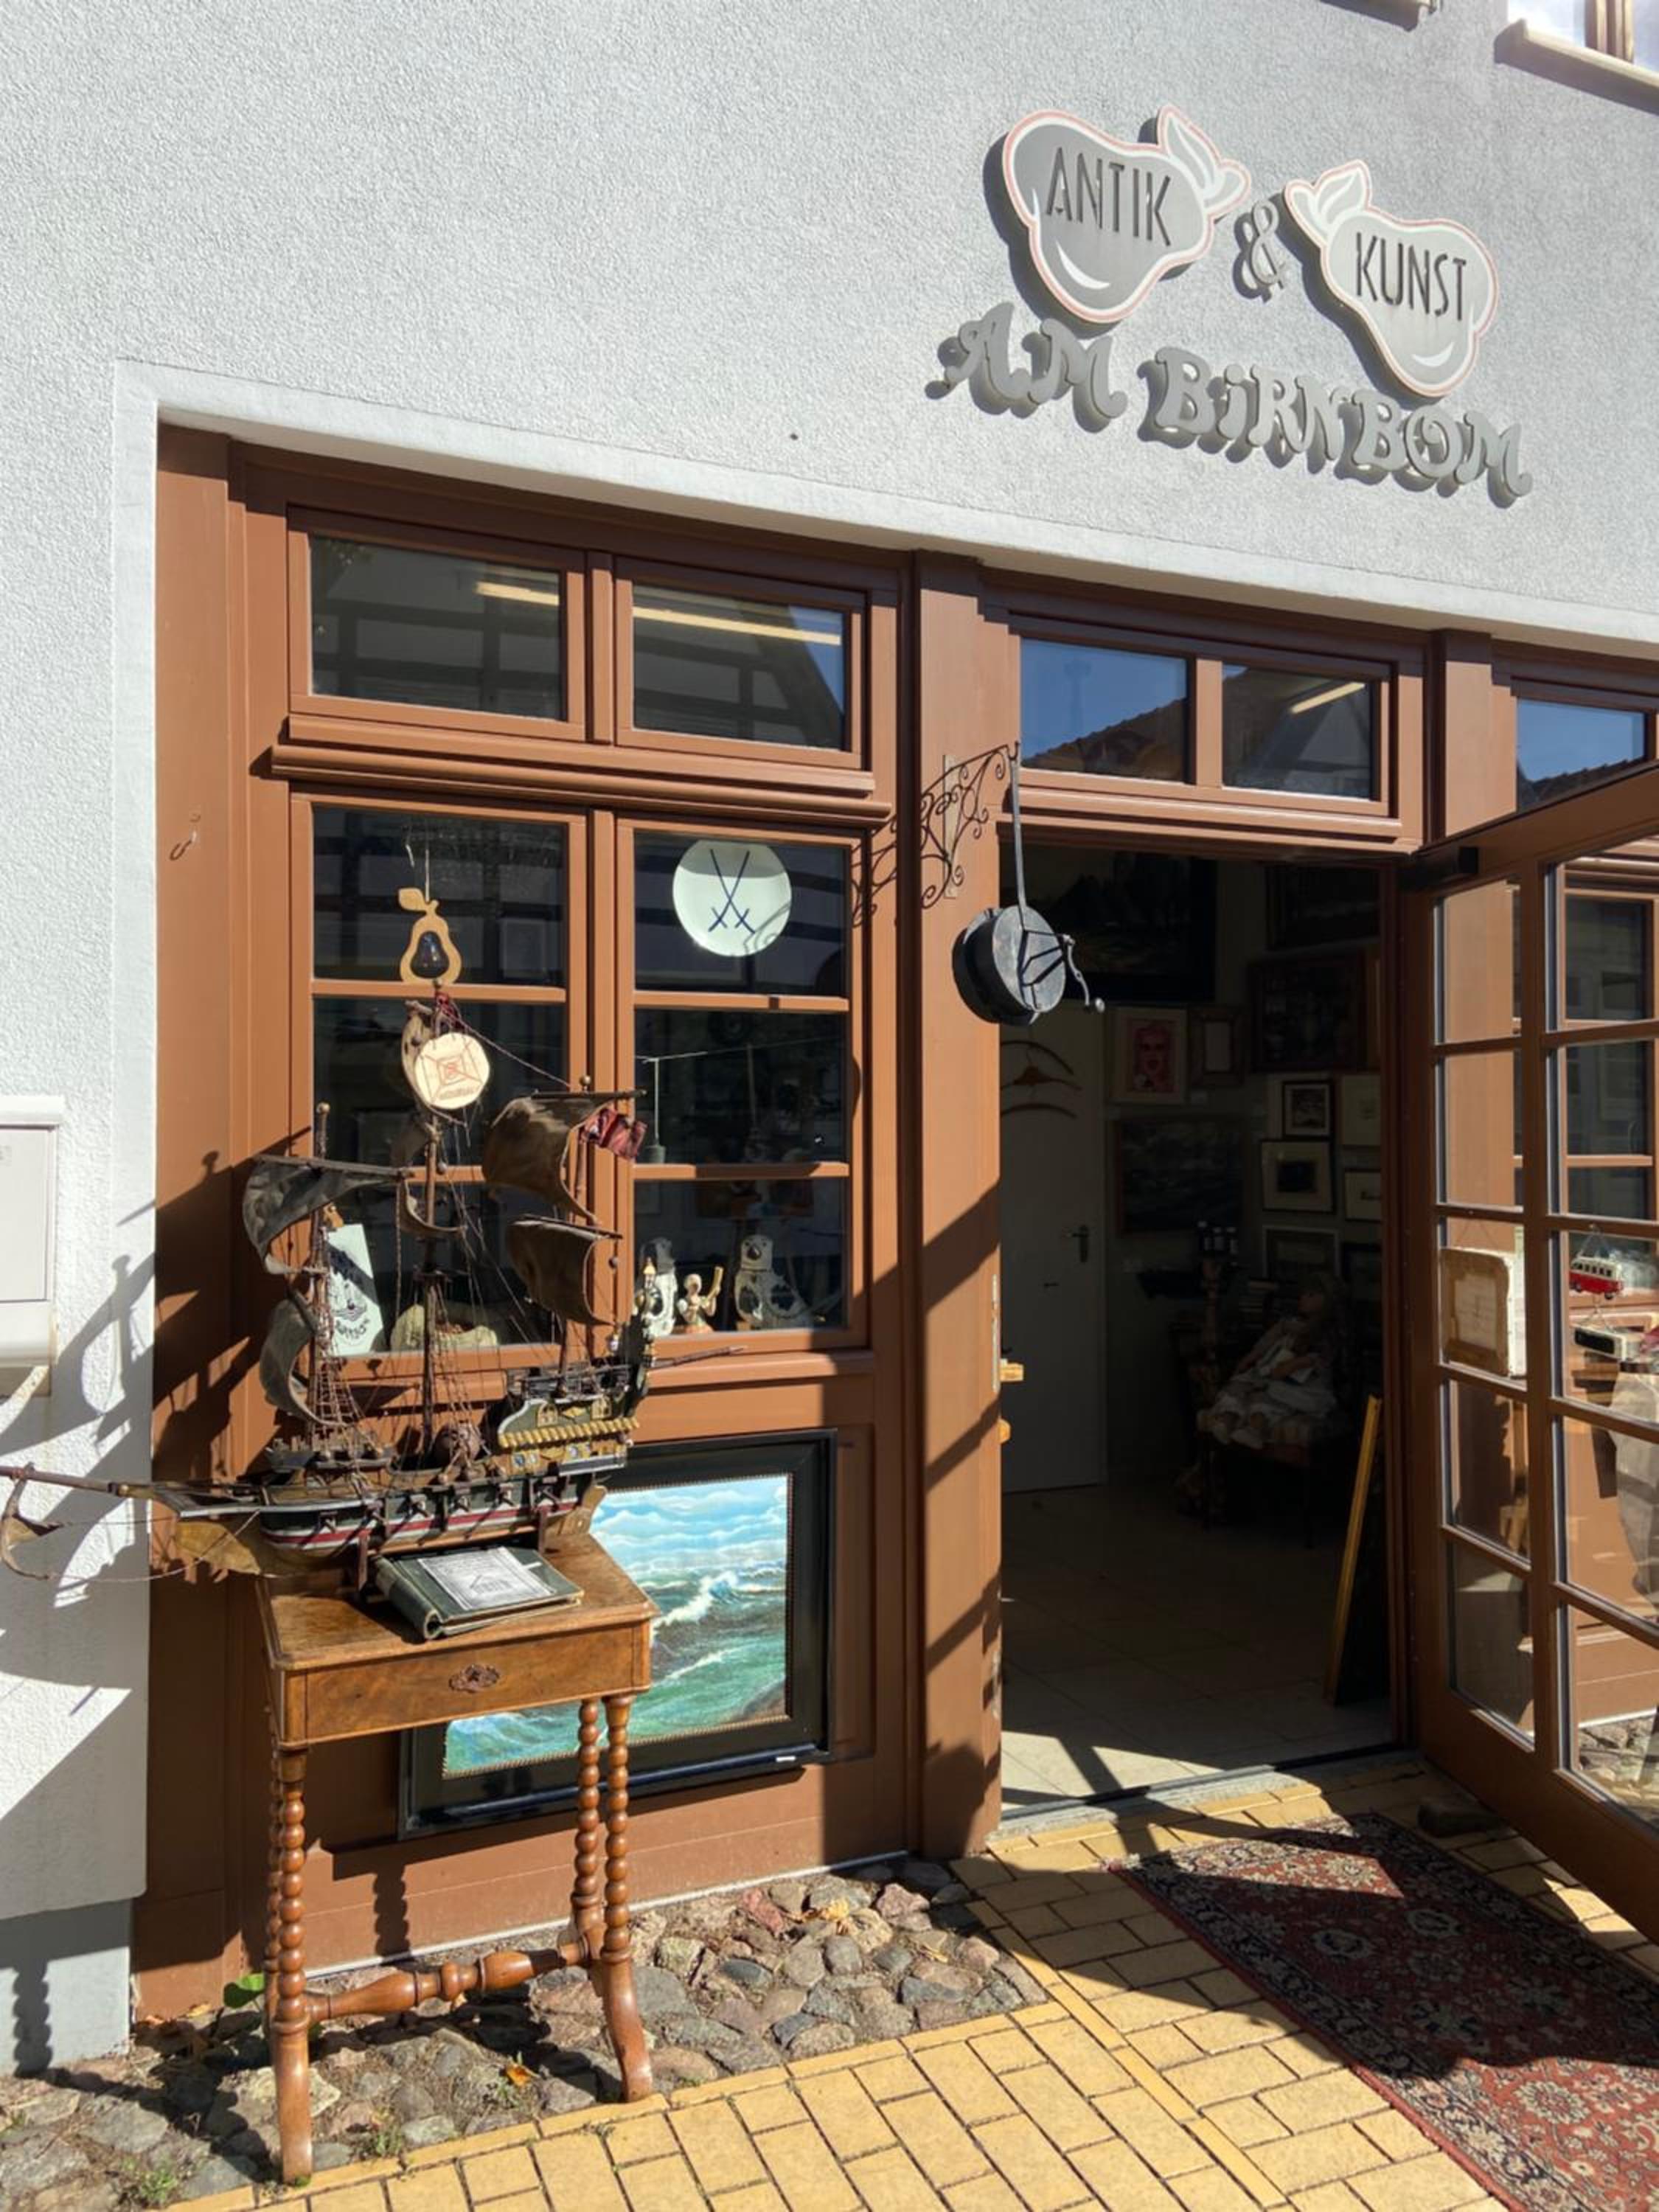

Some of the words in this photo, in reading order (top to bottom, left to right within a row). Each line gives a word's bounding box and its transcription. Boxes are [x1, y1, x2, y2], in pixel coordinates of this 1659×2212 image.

[1045, 146, 1172, 247] ANTIK
[1251, 198, 1285, 291] &
[1356, 231, 1467, 321] KUNST
[943, 301, 1129, 420] AM
